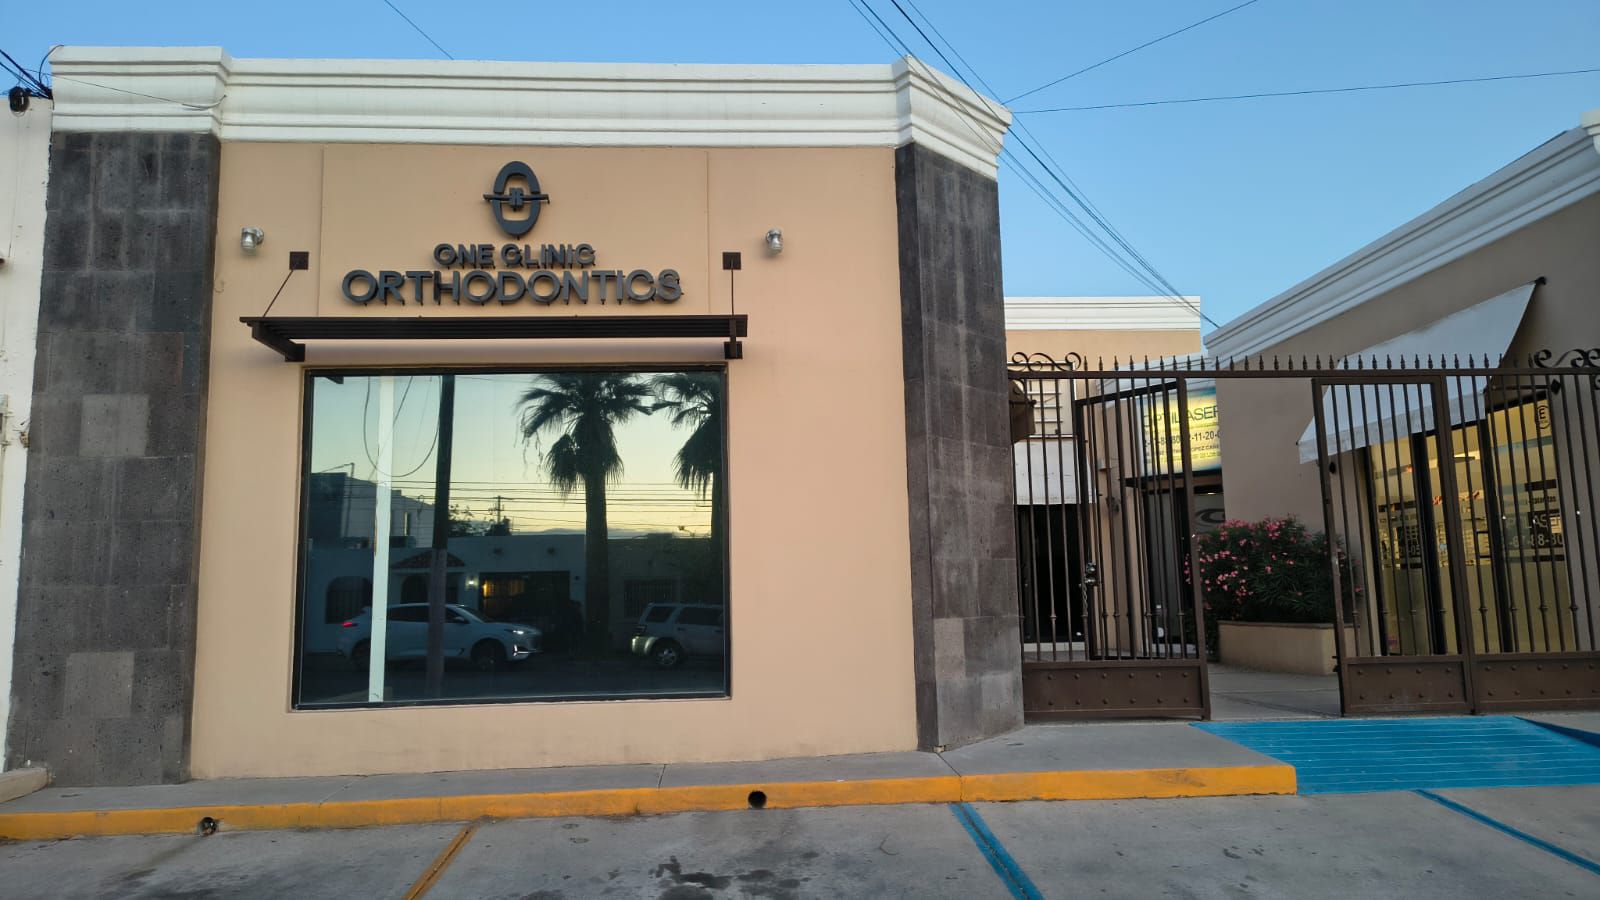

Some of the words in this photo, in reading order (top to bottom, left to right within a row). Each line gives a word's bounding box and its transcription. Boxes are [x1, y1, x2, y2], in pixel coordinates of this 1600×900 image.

[433, 243, 496, 266] ONE
[500, 243, 596, 266] CLINIC
[342, 269, 682, 302] ORTHODONTICS
